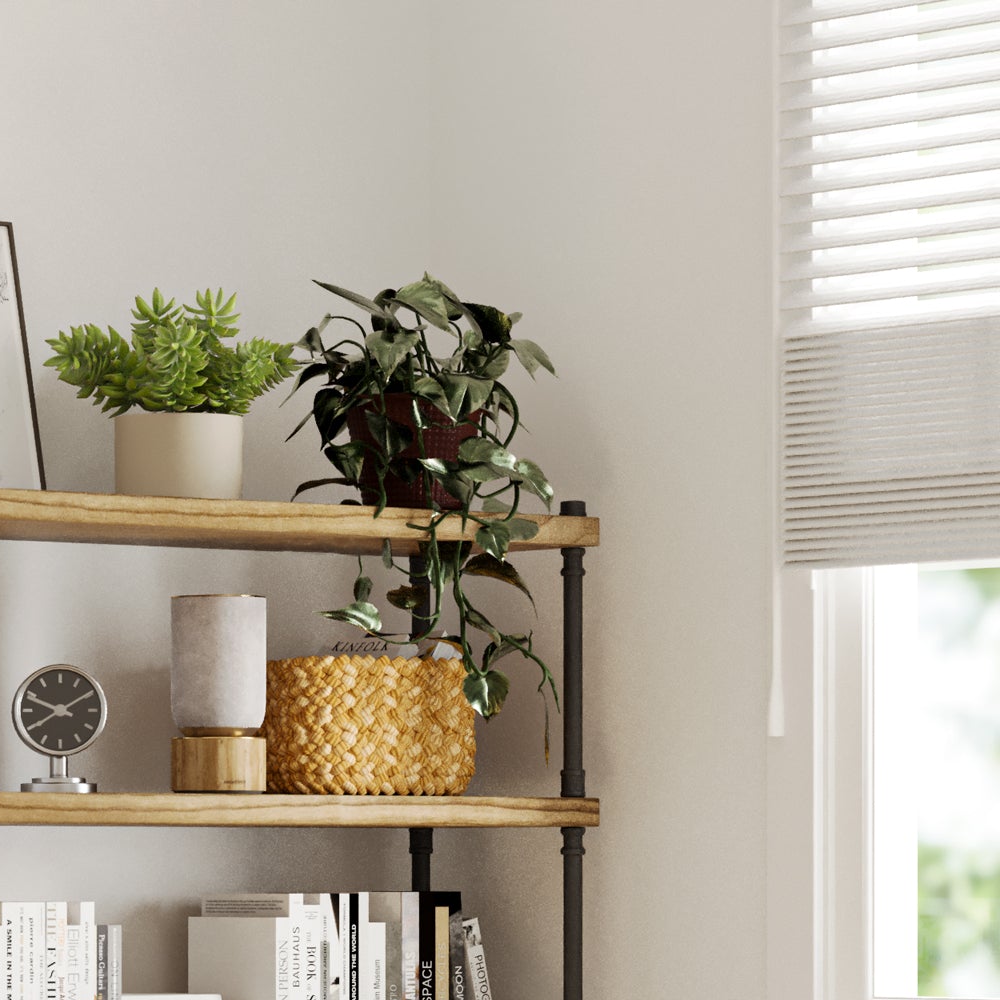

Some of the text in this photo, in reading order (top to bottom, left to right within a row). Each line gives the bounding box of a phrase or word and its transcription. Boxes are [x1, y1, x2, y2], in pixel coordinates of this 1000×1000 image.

[331, 640, 389, 652] KINFOLK
[47, 904, 56, 941] THE
[7, 960, 12, 971] IN
[68, 928, 80, 967] Elliott
[278, 940, 288, 990] PERSON
[292, 926, 300, 988] BAUHAUS
[306, 946, 316, 981] BOOK
